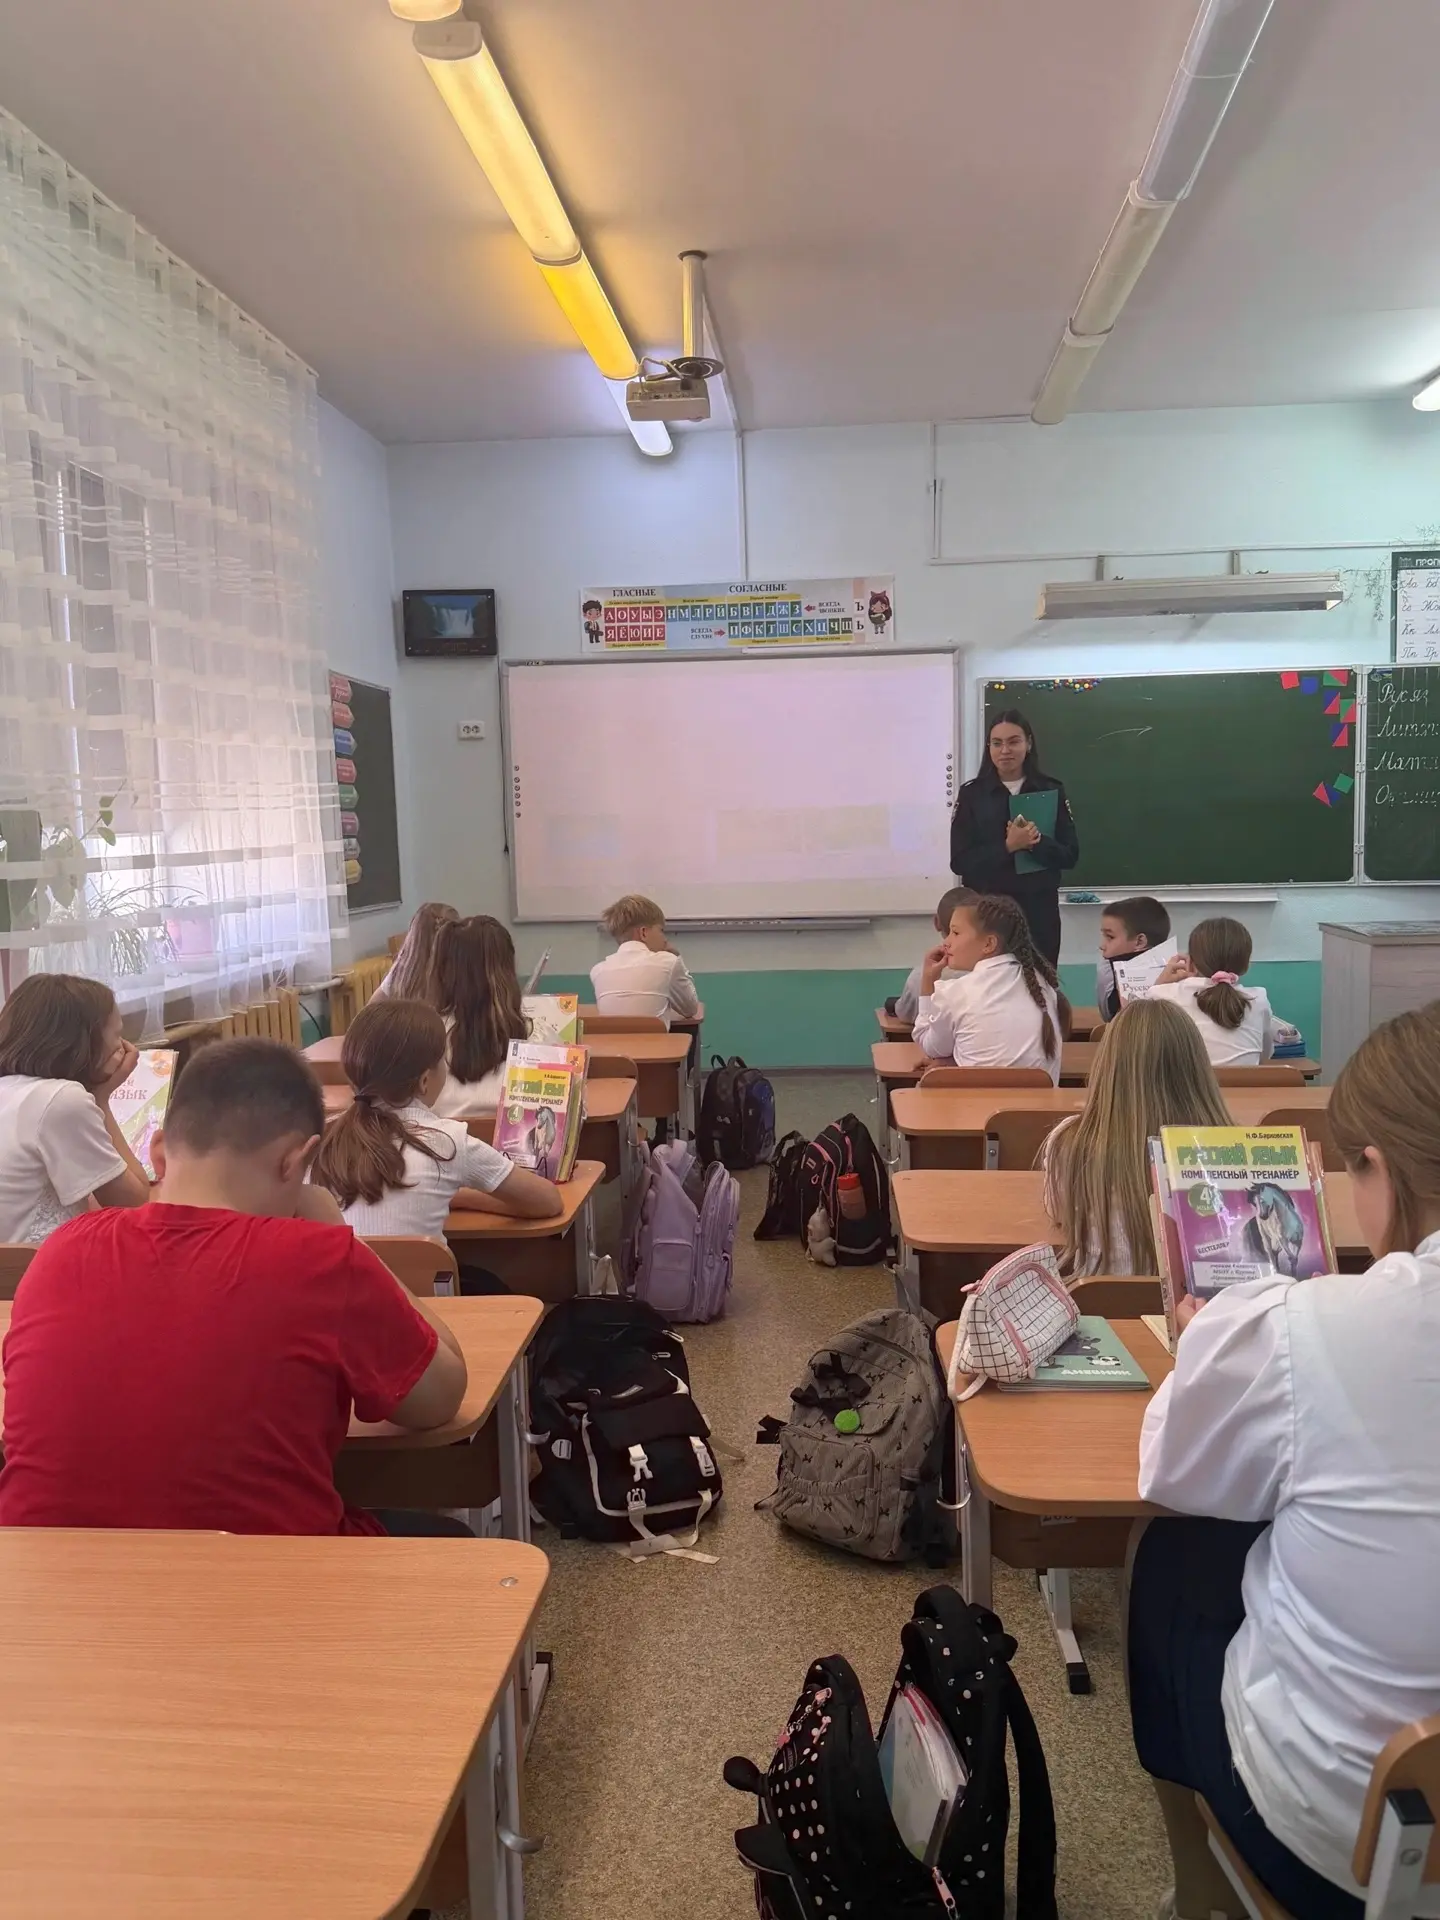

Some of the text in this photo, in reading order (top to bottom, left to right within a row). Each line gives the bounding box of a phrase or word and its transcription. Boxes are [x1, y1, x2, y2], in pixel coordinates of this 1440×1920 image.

[612, 589, 656, 597] ГЛАСНЫЕ
[729, 583, 788, 593] СОГЛАСНЫЕ
[605, 604, 800, 620] А О У Ы Э Н М Л Р Й Б В Г Д Ж З
[855, 601, 864, 611] Ъ
[607, 626, 665, 639] Я Ё Ю И Е
[730, 625, 738, 636] П
[741, 625, 752, 635] Ф
[755, 625, 763, 635] К
[768, 624, 776, 634] Т
[779, 624, 789, 634] Ш
[792, 623, 801, 633] С
[805, 622, 814, 633] Х
[817, 622, 827, 634] Ц
[830, 621, 838, 631] Ч
[1251, 1145, 1298, 1165] ЯЗЫК
[1250, 1169, 1300, 1180] ТРЕНАЖЁР
[1200, 1186, 1212, 1205] 4
